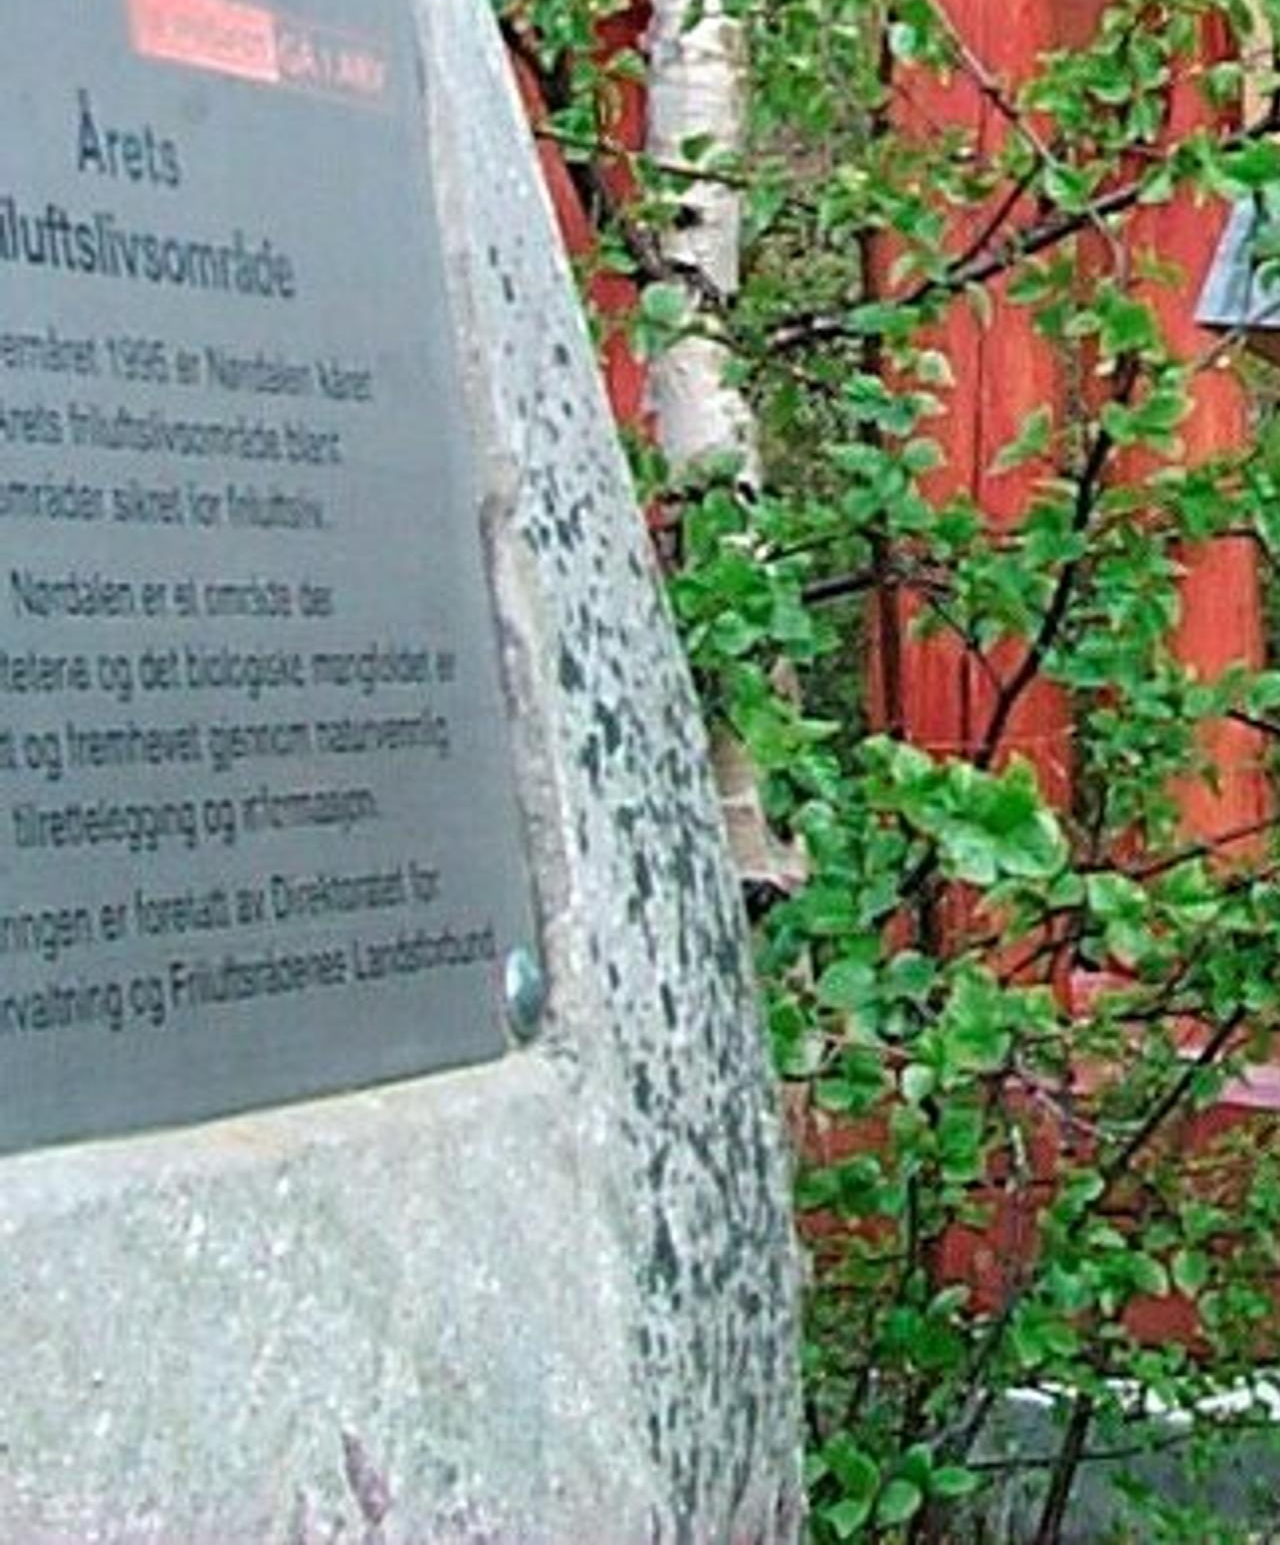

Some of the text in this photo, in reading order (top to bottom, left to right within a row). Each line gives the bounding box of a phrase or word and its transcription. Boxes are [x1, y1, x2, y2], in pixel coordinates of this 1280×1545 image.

[77, 88, 180, 189] Årets
[101, 657, 135, 703] og
[25, 731, 63, 782] og
[203, 797, 238, 846] og
[129, 973, 166, 1026] og
